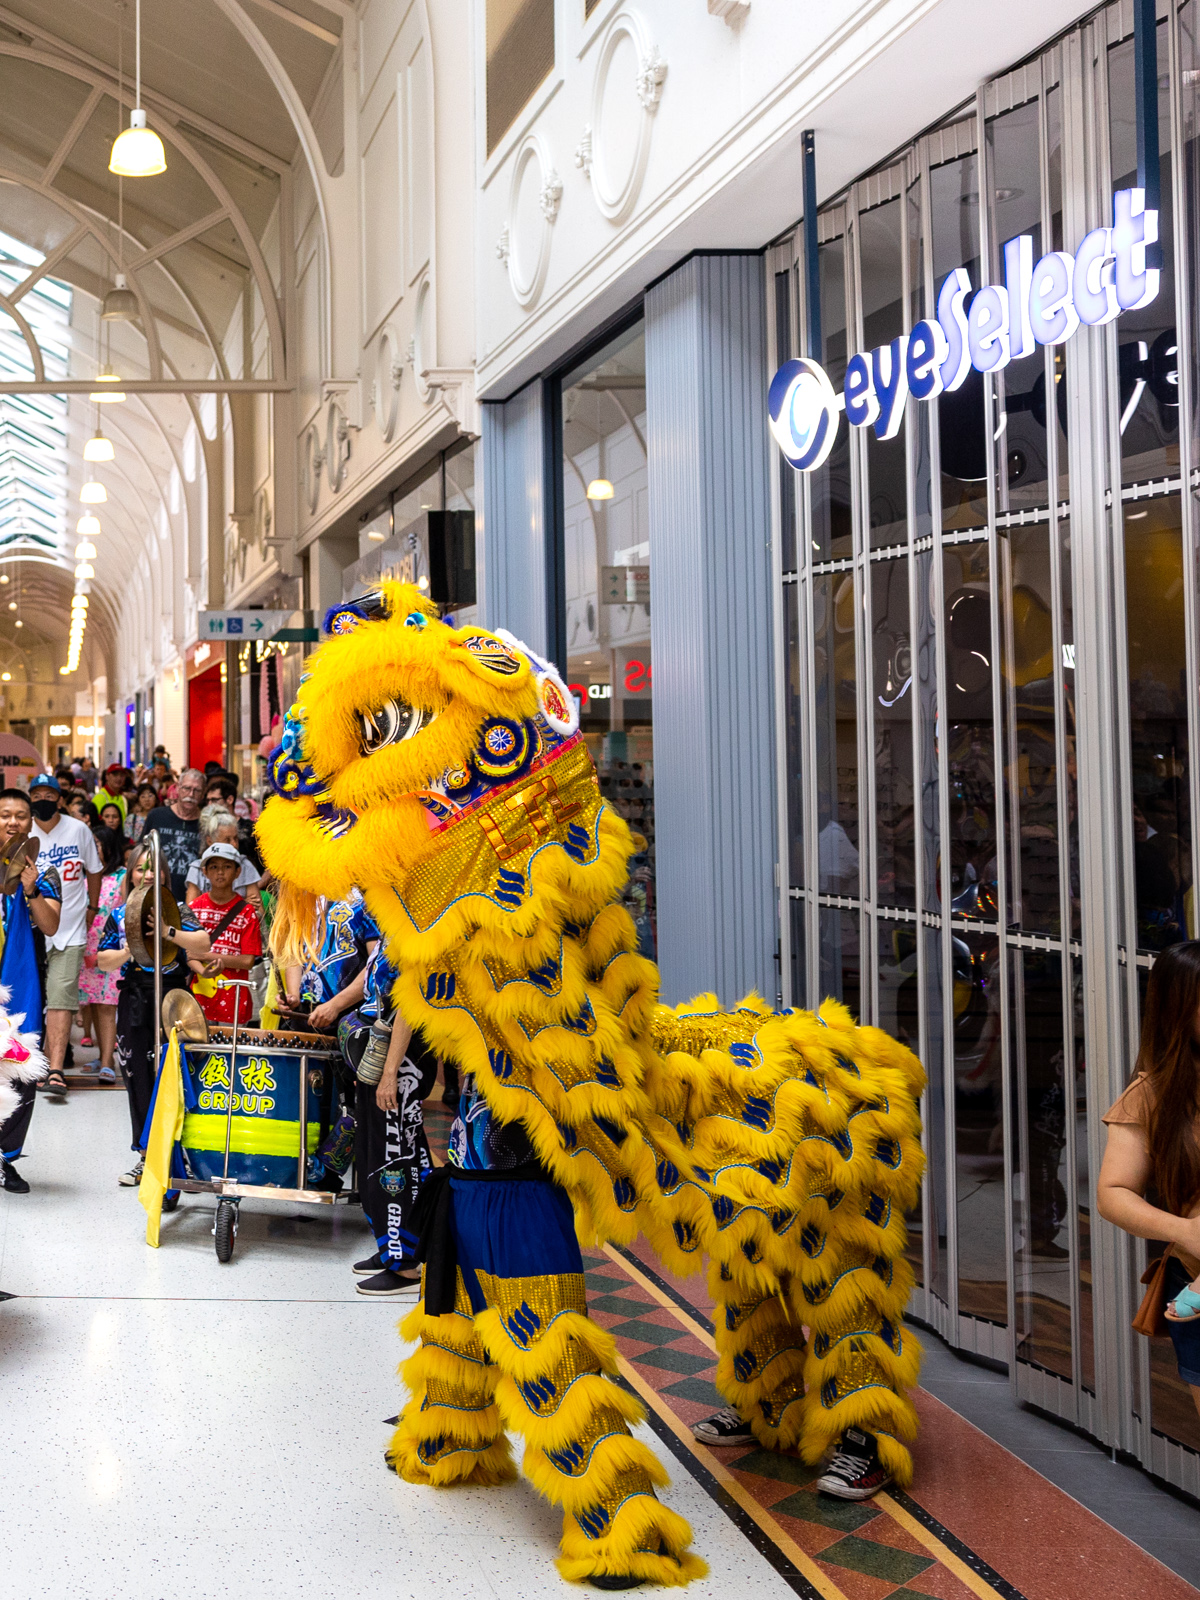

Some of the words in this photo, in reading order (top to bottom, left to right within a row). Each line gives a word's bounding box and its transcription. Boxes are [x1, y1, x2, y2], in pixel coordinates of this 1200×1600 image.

[843, 188, 1161, 441] eyeSelect
[478, 775, 582, 860] LTL
[63, 860, 83, 882] 22
[199, 1091, 276, 1115] GROUP
[387, 1203, 402, 1260] GROUP
